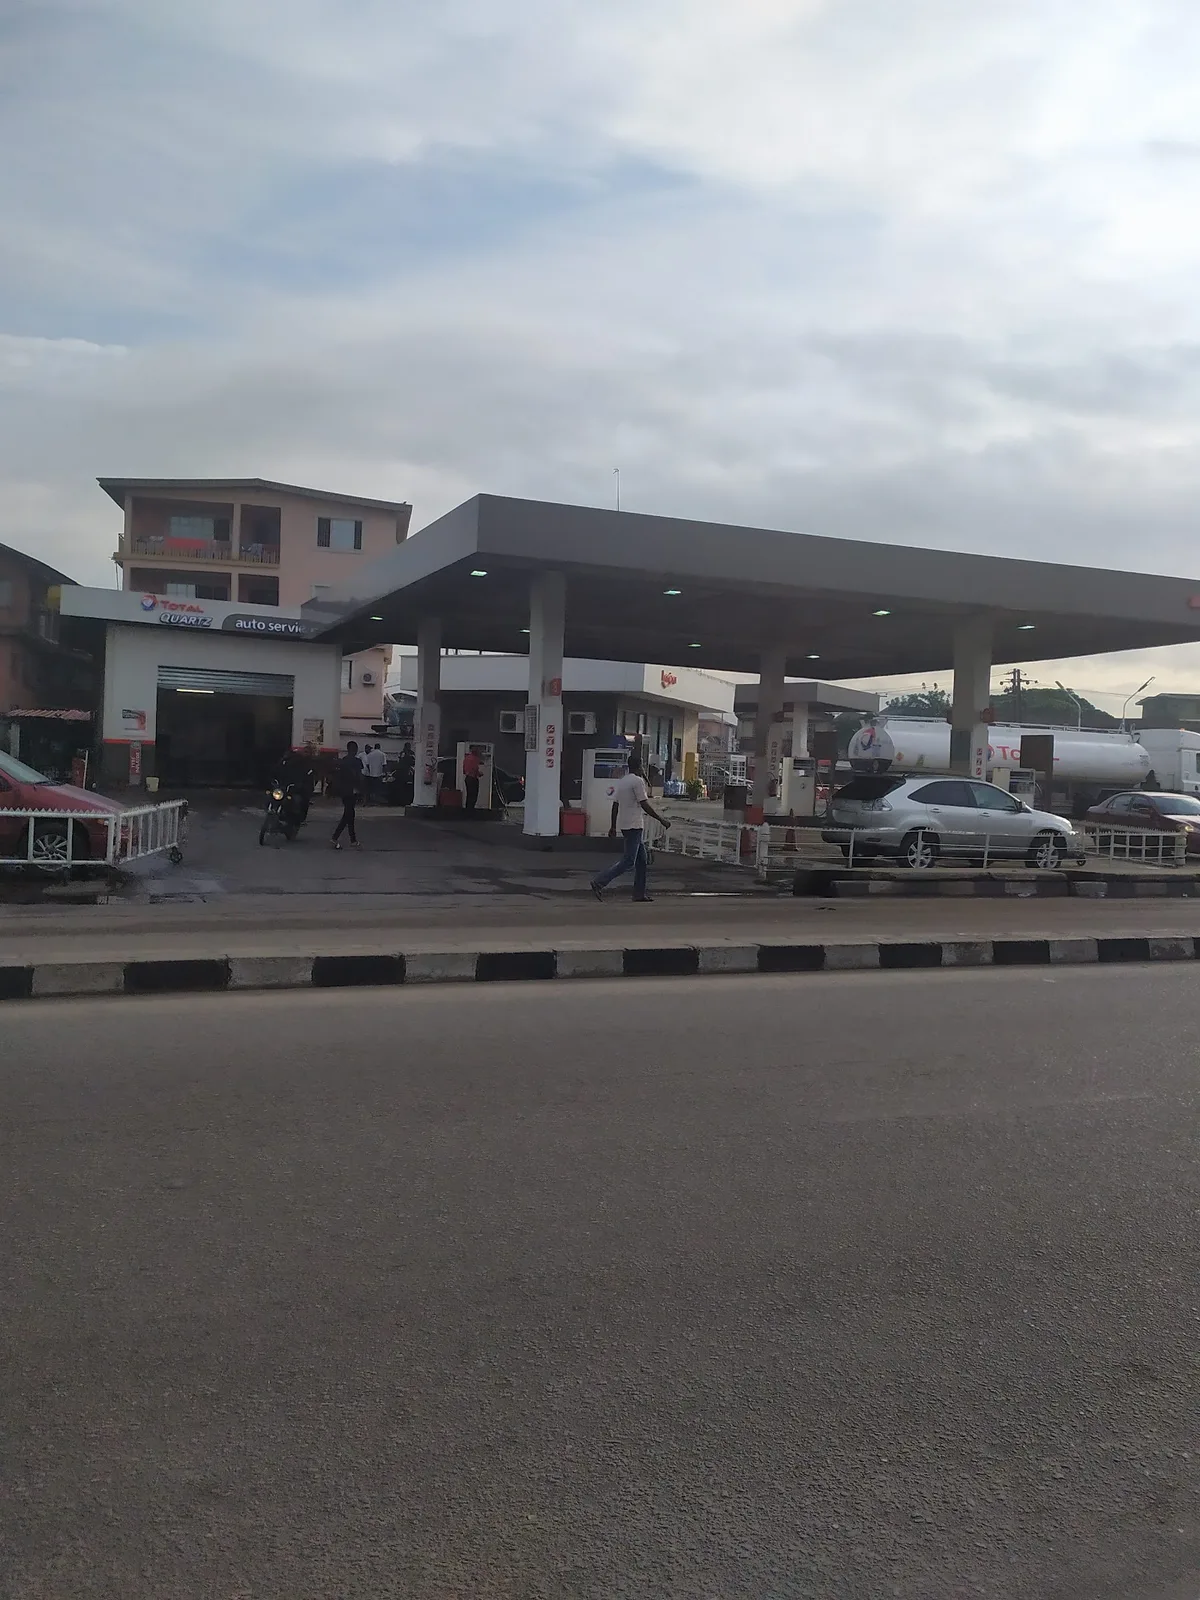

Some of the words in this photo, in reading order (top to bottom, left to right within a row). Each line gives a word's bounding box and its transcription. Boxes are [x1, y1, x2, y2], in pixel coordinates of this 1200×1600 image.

[160, 600, 204, 613] TOTAL
[160, 612, 213, 627] QUARTZ
[235, 618, 266, 630] auto
